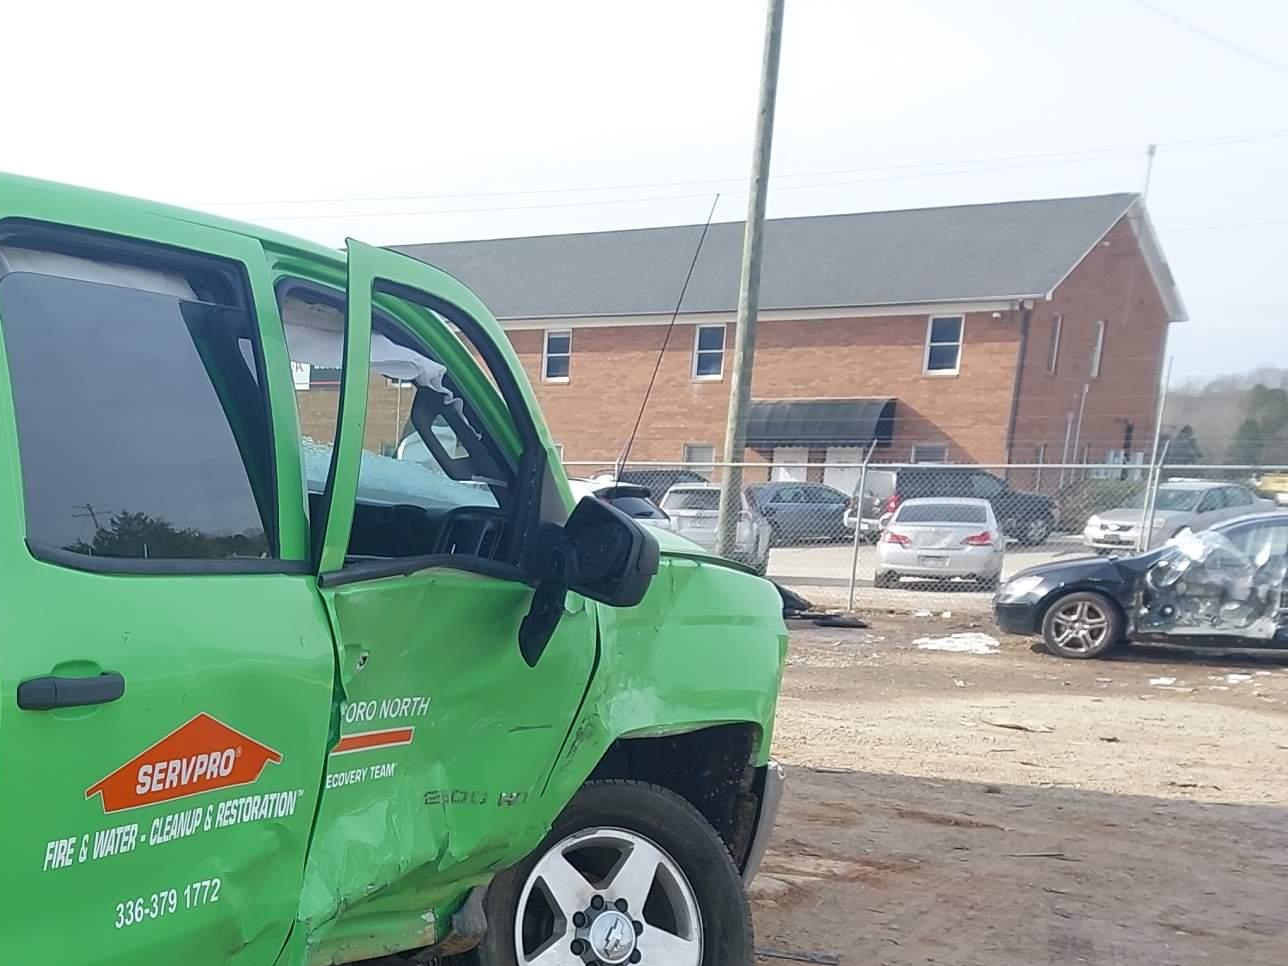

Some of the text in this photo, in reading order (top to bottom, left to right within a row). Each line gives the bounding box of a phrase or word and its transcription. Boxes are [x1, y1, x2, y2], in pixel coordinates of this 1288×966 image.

[344, 696, 431, 724] ORO NORTH
[43, 834, 77, 872] FIRE
[78, 833, 90, 864] &
[93, 823, 140, 860] WATER
[149, 813, 203, 846] CLEANUP
[203, 804, 215, 832] &
[114, 878, 222, 929] 336-379 1772
